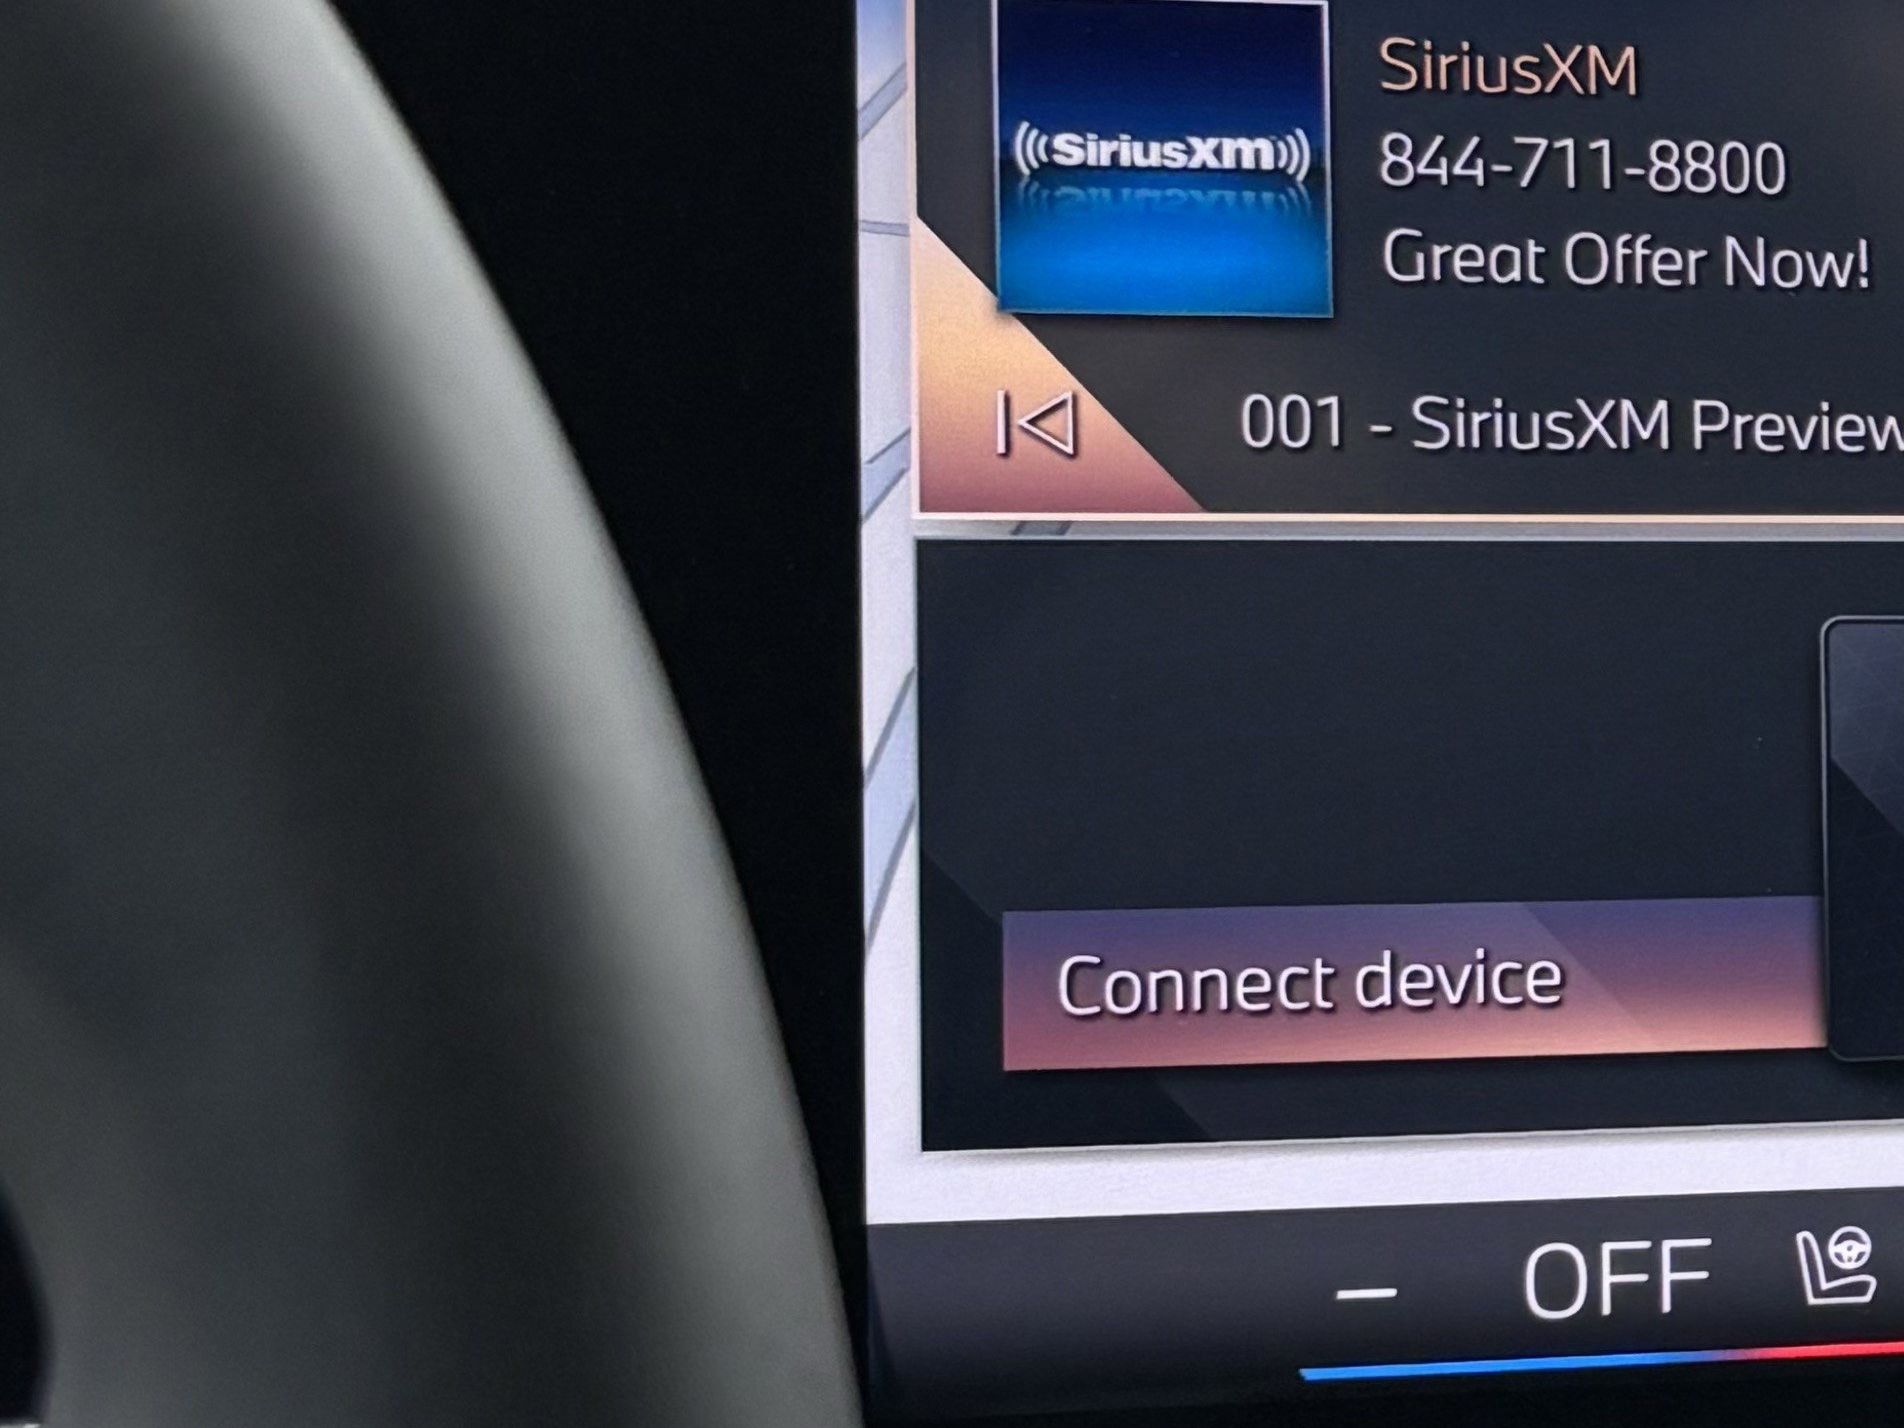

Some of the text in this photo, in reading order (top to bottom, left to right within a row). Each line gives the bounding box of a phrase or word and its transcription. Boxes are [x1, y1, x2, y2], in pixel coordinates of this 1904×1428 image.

[1379, 36, 1637, 97] SiriusXM
[1380, 132, 1787, 195] 844-711-8800
[1383, 227, 1870, 289] Great Offer Now!
[1241, 393, 1344, 449] 001
[1411, 395, 1669, 451] SiriusXM
[1058, 947, 1563, 1016] Connect device
[1524, 1237, 1713, 1320] OFF
